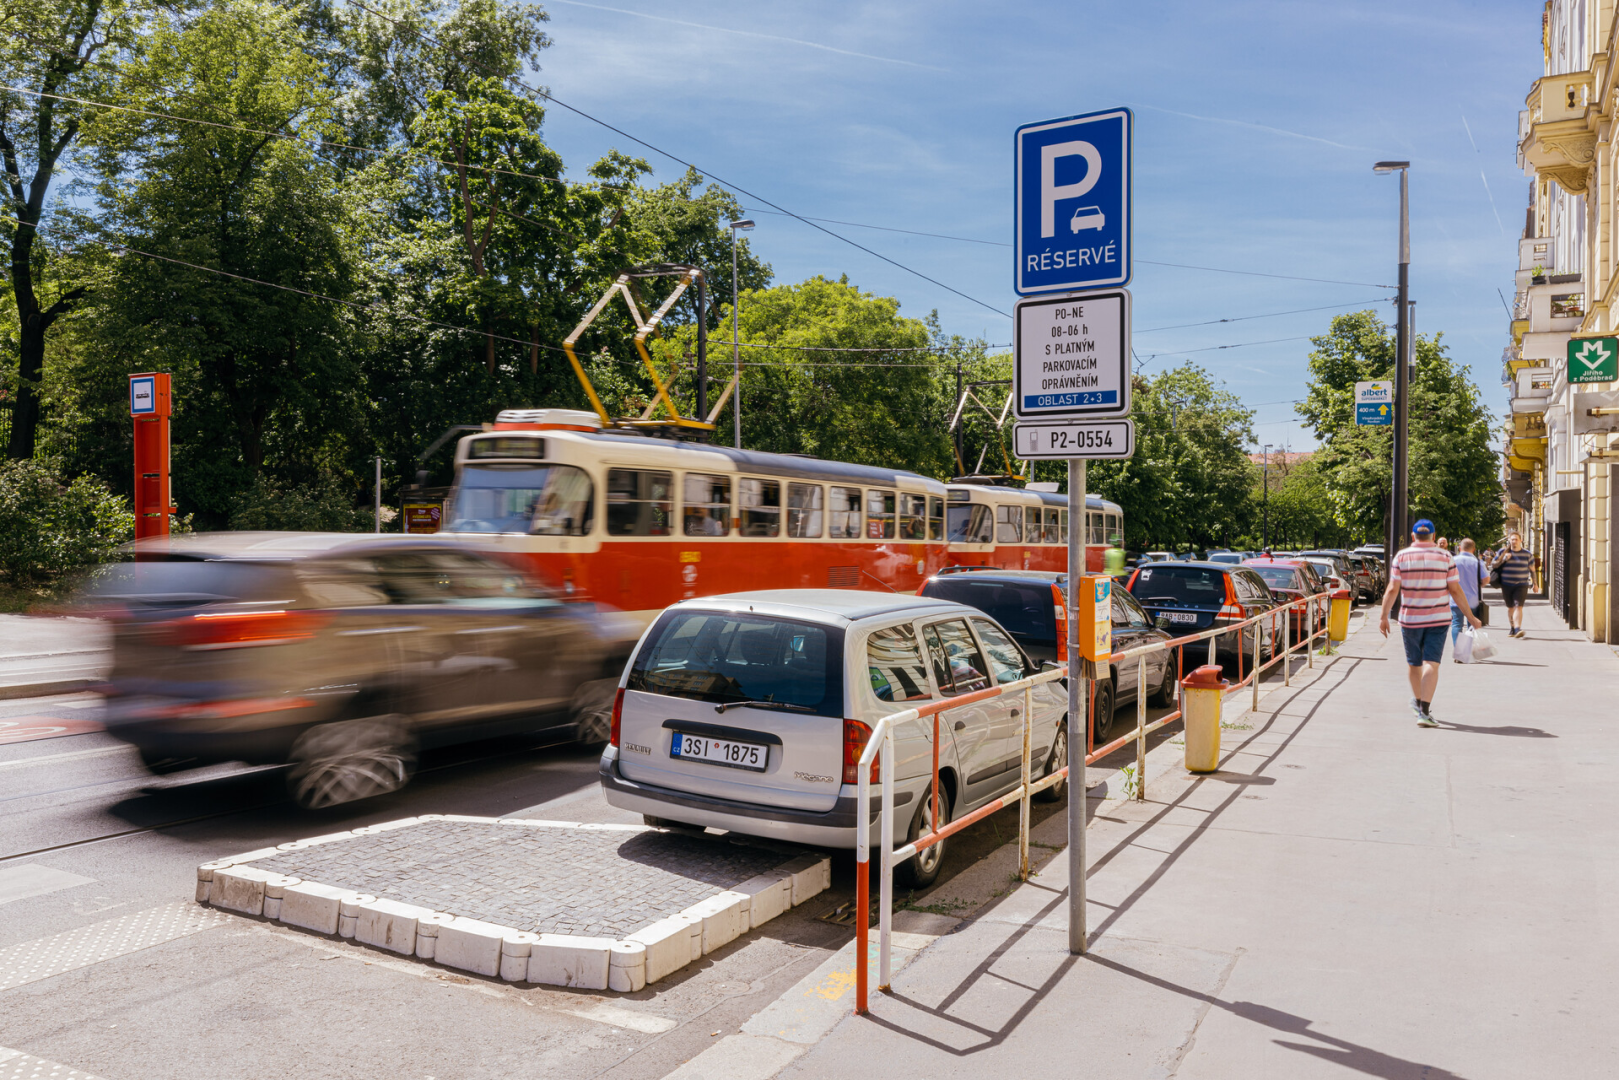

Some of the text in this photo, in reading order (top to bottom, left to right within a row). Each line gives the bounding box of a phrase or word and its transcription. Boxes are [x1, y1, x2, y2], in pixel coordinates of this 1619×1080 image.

[1041, 140, 1102, 238] P
[1027, 240, 1116, 272] RÉSERVÉ
[1055, 306, 1084, 320] PO-NE
[1051, 324, 1088, 338] 08-06 h
[1045, 338, 1095, 355] S PLATNÝM
[1043, 355, 1097, 373] PARKOVACÍM
[1042, 373, 1098, 390] OPRÁVNĚNÍM
[1038, 394, 1079, 407] OBLAST
[1361, 388, 1388, 396] albert
[1050, 430, 1113, 449] P2-0554
[684, 738, 709, 757] 3SI
[723, 743, 760, 764] 1875
